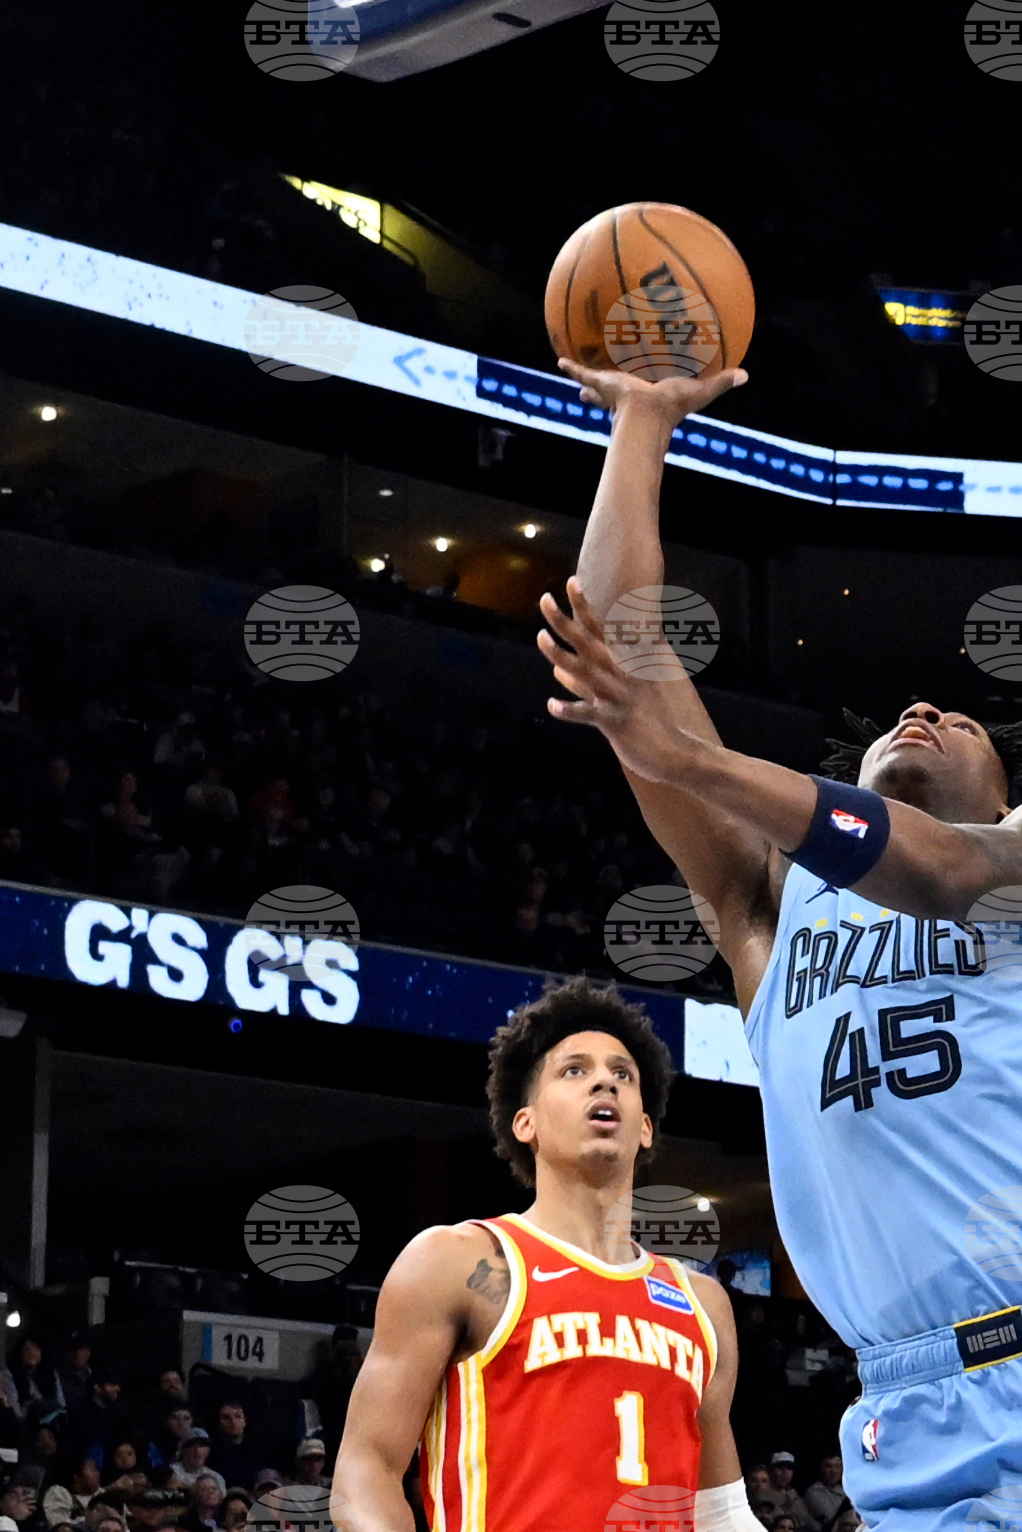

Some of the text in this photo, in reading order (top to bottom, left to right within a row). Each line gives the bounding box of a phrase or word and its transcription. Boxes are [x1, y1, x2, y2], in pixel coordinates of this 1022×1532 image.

[64, 900, 360, 1024] G'S G'S
[820, 994, 962, 1112] 45
[223, 1332, 265, 1363] 104
[524, 1311, 704, 1406] ATLANTA
[614, 1390, 649, 1487] 1
